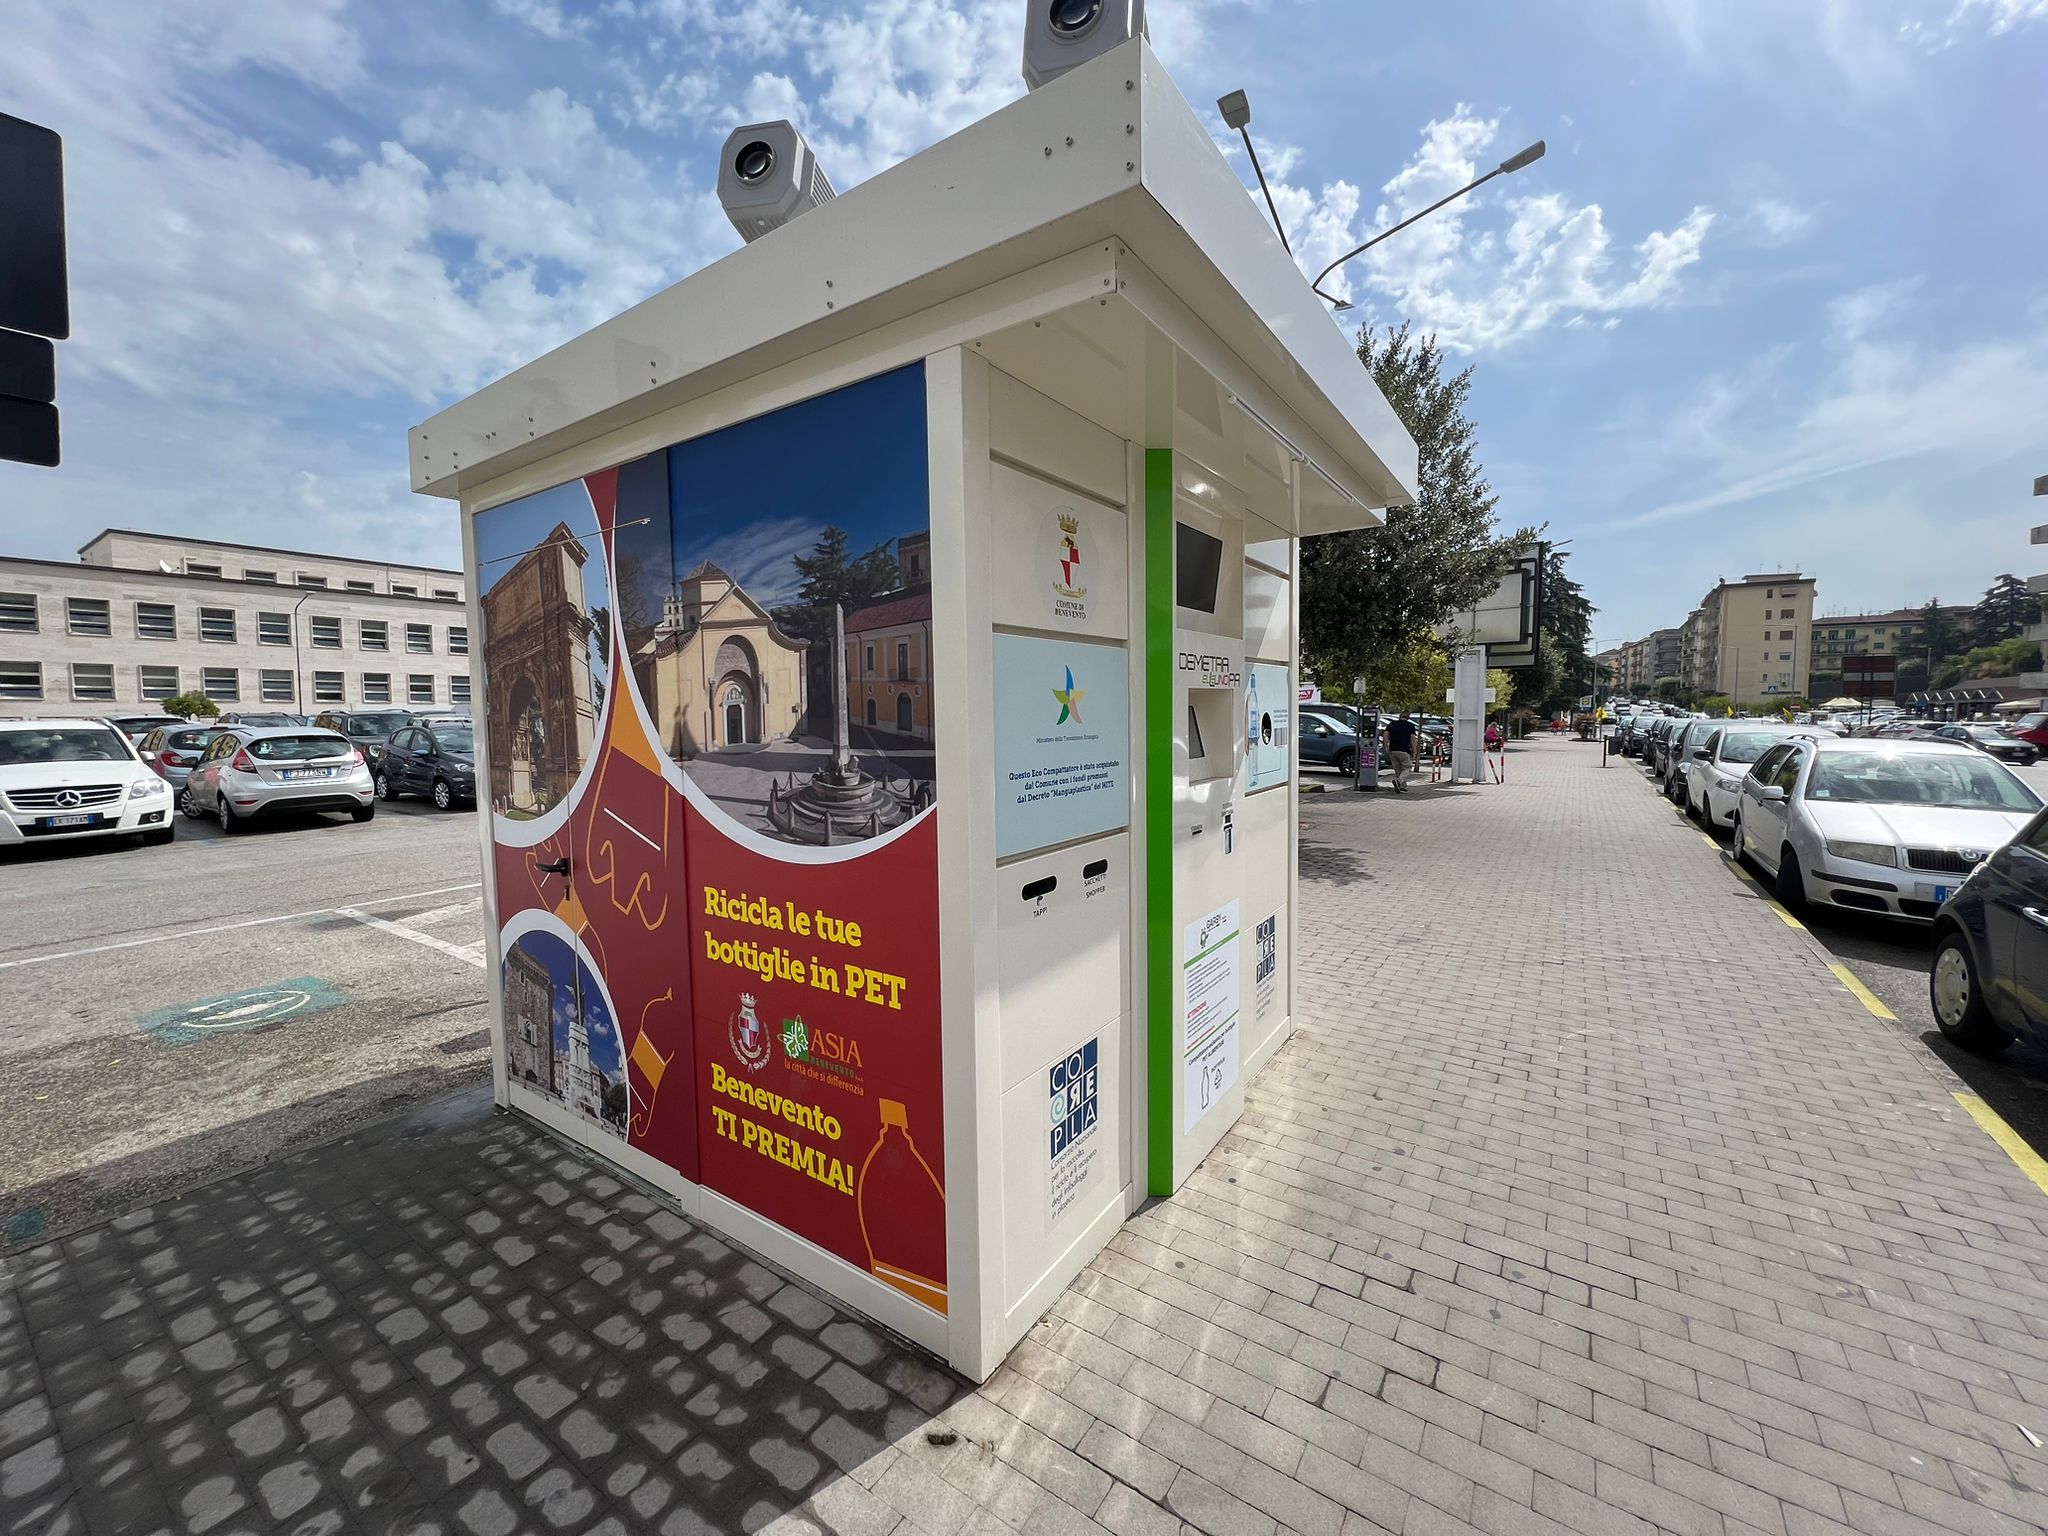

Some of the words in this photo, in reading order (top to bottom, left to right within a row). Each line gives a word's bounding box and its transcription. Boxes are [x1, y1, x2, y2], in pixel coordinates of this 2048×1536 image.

[1055, 608, 1086, 620] BENEVENTO
[1056, 600, 1078, 610] COMUNE
[1179, 652, 1229, 673] DEMETRA
[1009, 771, 1030, 780] Questo
[1043, 766, 1079, 776] Compattatore
[1096, 761, 1119, 769] acquistato
[1025, 781, 1034, 790] dal
[1035, 779, 1058, 789] Comune
[1073, 774, 1086, 782] fondi
[1017, 795, 1026, 803] dal
[1028, 792, 1050, 801] Decreto
[1085, 885, 1106, 899] SHOPPER
[703, 886, 784, 931] Ricicla
[786, 901, 811, 936] le
[815, 909, 862, 948] tue
[1033, 907, 1048, 918] TAPPI
[704, 931, 806, 984] bottiglie
[810, 956, 840, 994] in
[844, 963, 906, 1010] PET
[810, 1028, 863, 1068] ASIA
[784, 1058, 791, 1070] la
[791, 1061, 806, 1076] città
[807, 1069, 819, 1081] che
[820, 1072, 825, 1083] si
[826, 1072, 864, 1096] differenzia
[810, 1056, 855, 1079] BENEVENTO
[711, 1062, 842, 1141] Benevento
[712, 1105, 738, 1142] TI
[741, 1118, 854, 1197] PREMIA!
